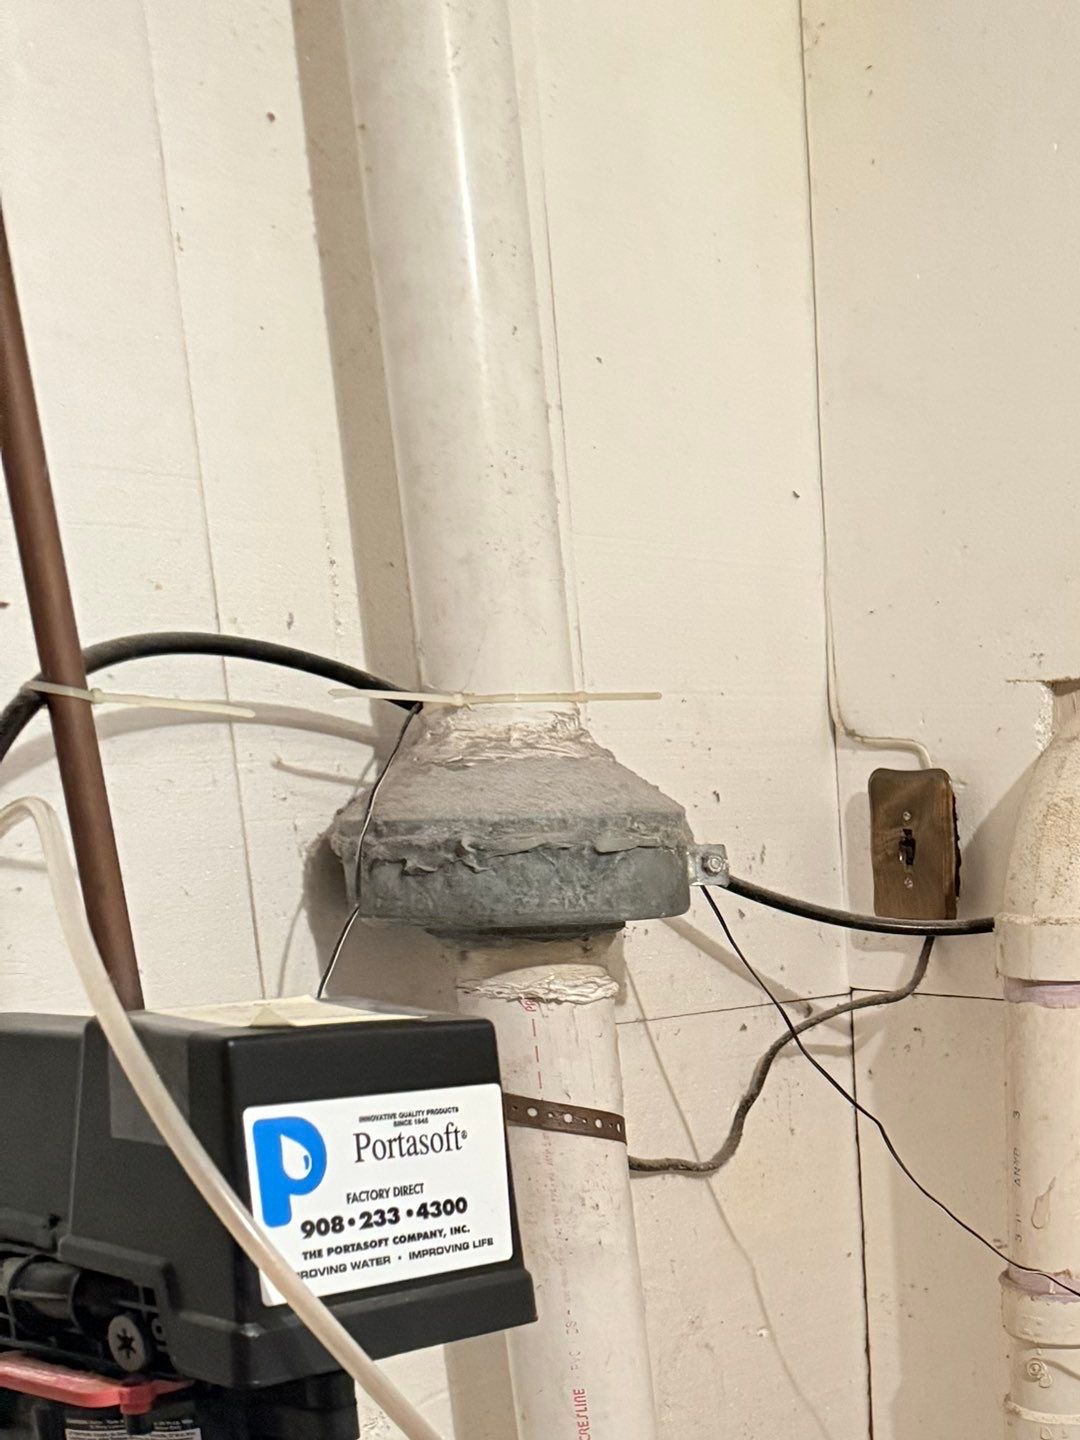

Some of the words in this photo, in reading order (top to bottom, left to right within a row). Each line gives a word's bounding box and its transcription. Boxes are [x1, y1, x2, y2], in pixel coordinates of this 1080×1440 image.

[359, 1111, 398, 1123] INNOVATIVE
[398, 1109, 426, 1120] QUALITY
[426, 1105, 460, 1116] PRODUCTS
[393, 1119, 413, 1128] SINCE
[346, 1187, 391, 1205] FACTORY
[392, 1182, 425, 1200] DIRECT
[302, 1250, 324, 1261] THE
[326, 1237, 390, 1257] PORTASOFT
[392, 1228, 448, 1246] COMPANY,
[449, 1224, 472, 1237] INC.
[350, 1255, 392, 1272] WATER
[408, 1240, 471, 1262] IMPROVING
[472, 1236, 495, 1249] LIFE
